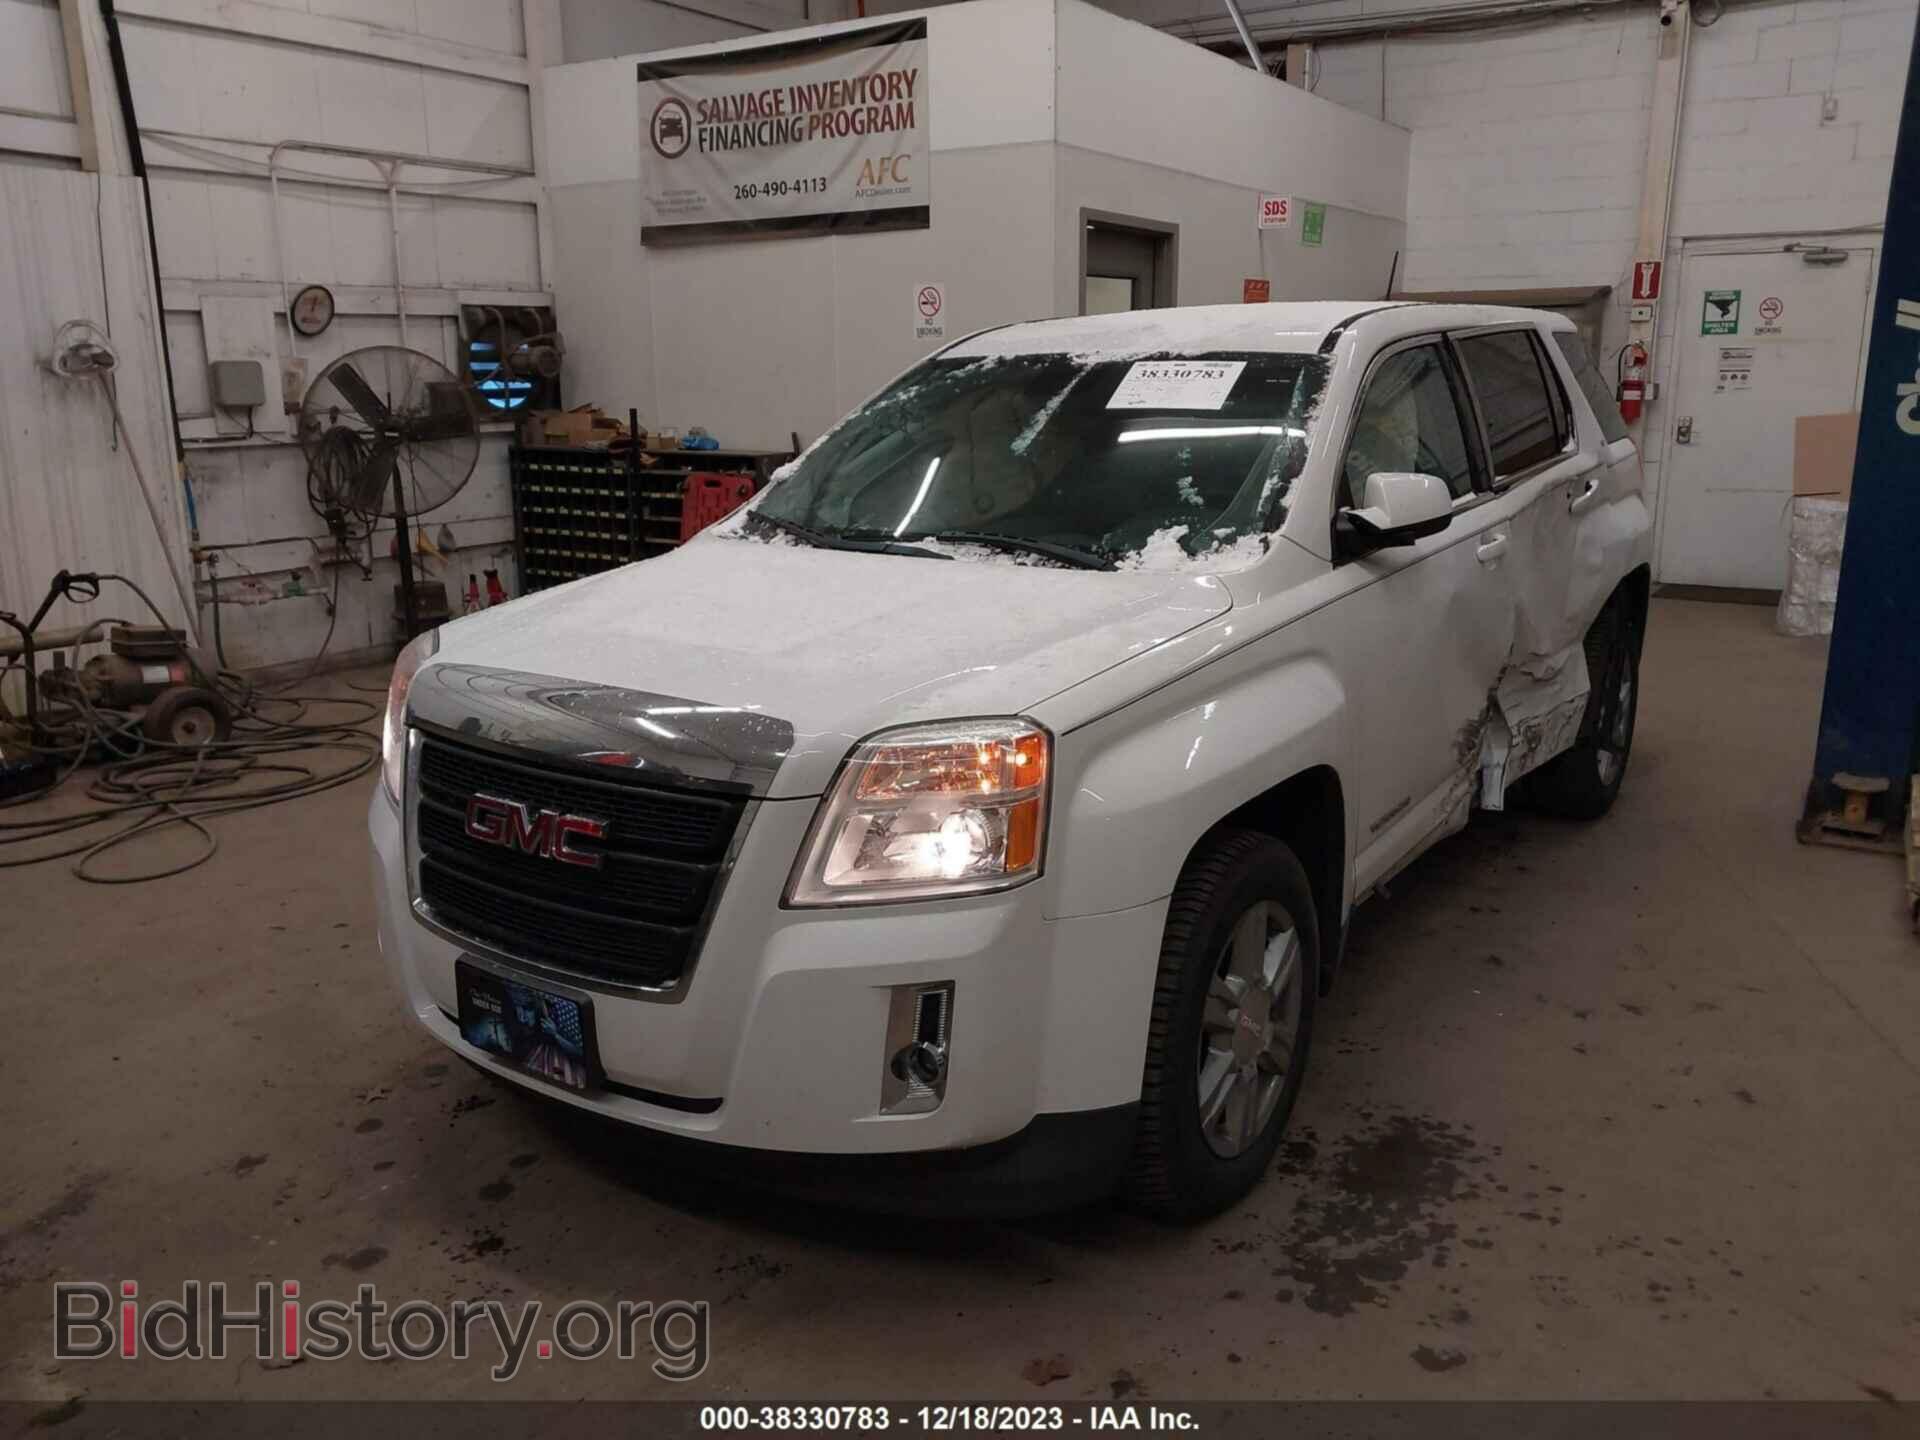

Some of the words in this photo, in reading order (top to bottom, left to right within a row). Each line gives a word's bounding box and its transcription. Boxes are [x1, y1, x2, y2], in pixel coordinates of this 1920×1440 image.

[696, 88, 786, 126] SALVAGE
[789, 68, 918, 113] INVENTORY
[698, 116, 804, 153] FINANCING
[807, 101, 915, 141] PROGRAM
[856, 154, 912, 187] AFC
[734, 177, 827, 200] 260-490-4113
[1264, 200, 1287, 216] SDS
[1138, 369, 1225, 379] 38330783
[465, 792, 609, 870] GMC
